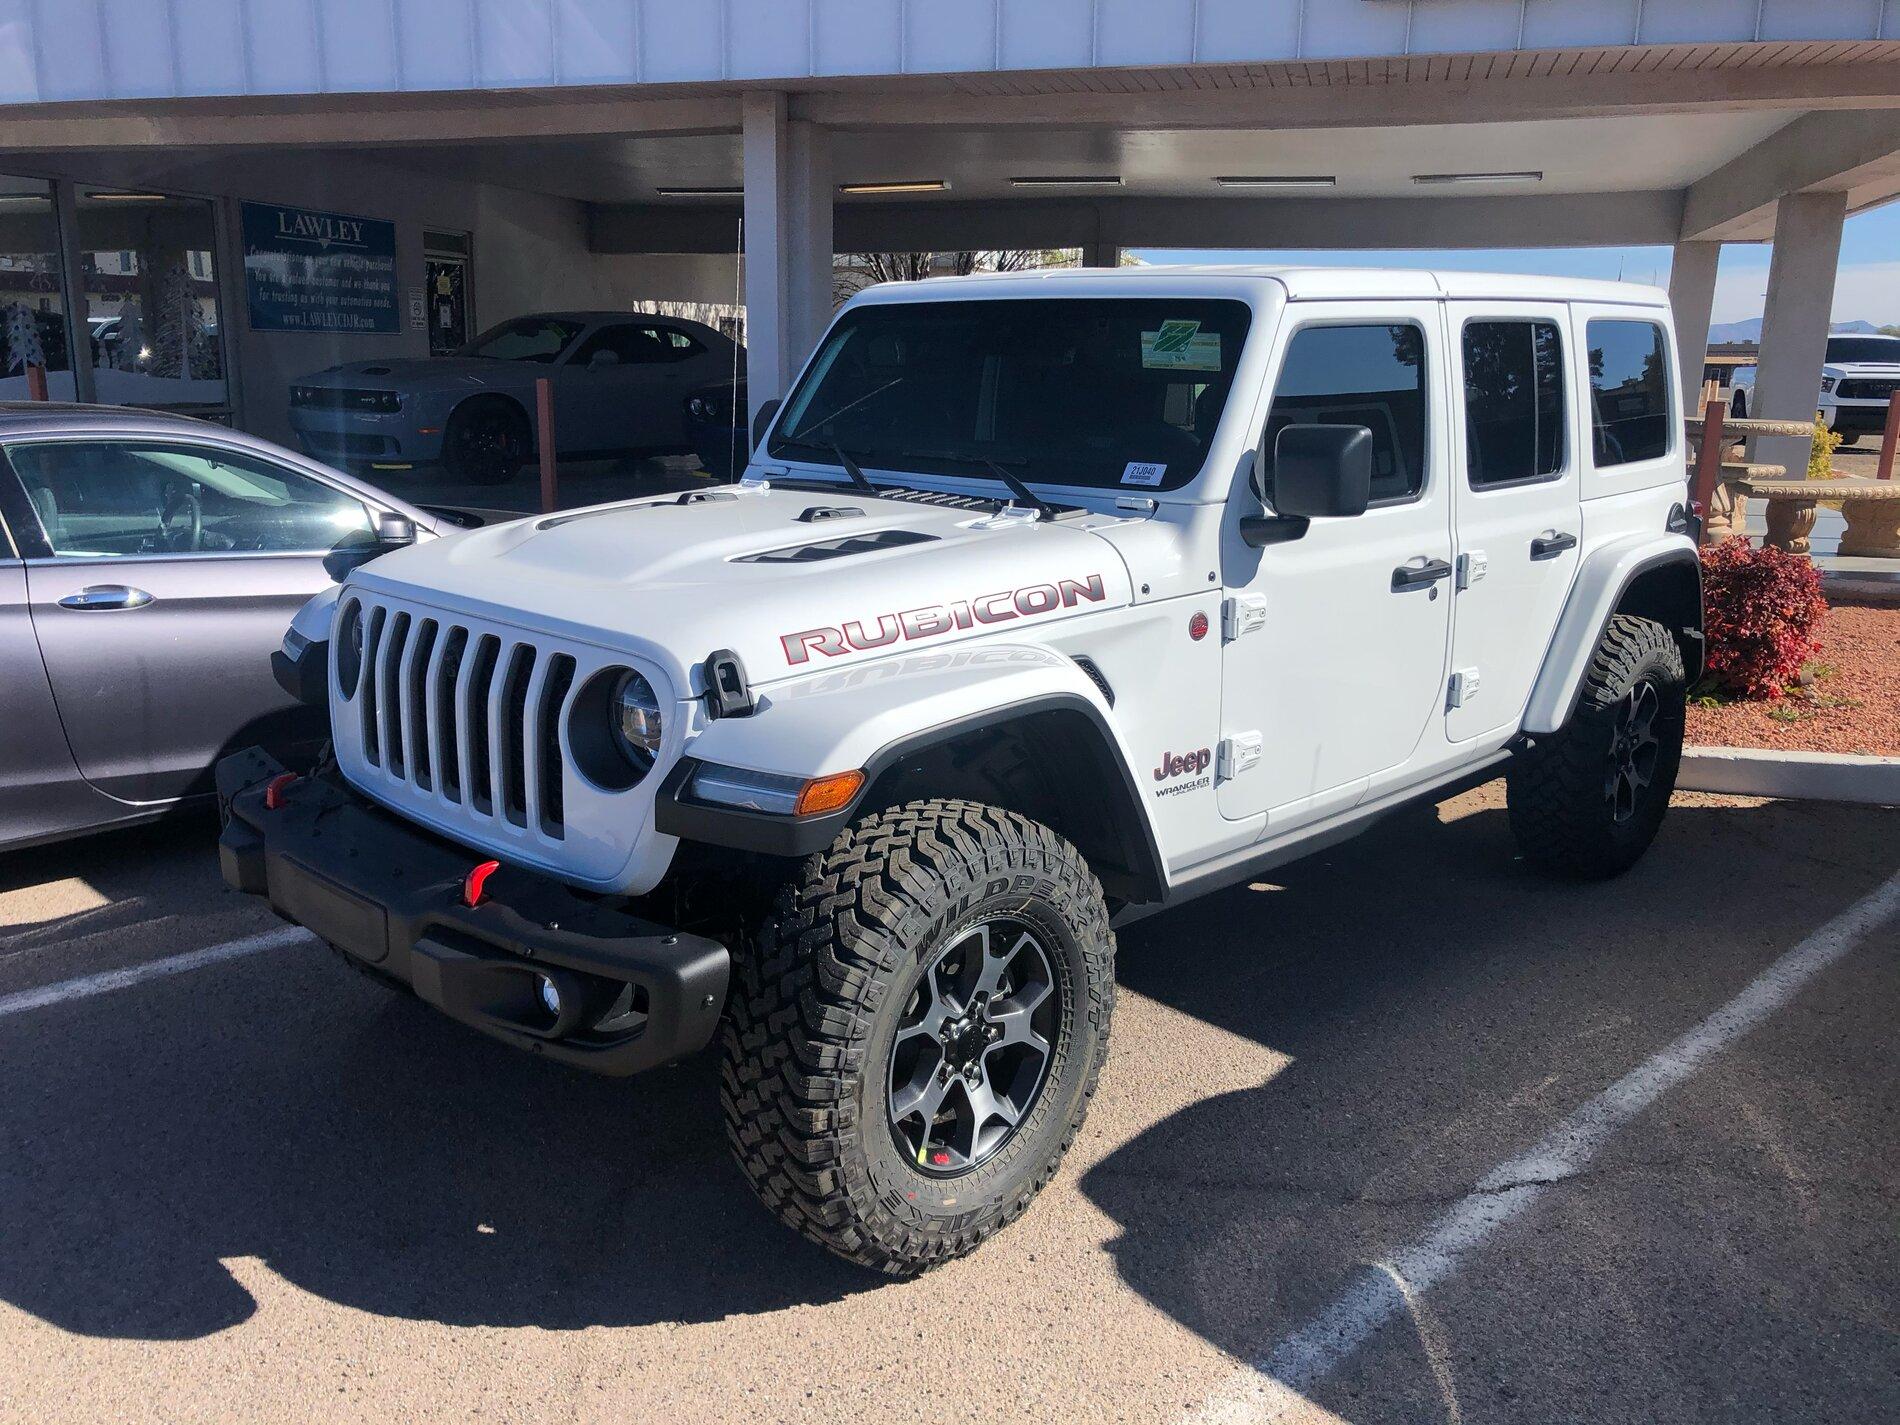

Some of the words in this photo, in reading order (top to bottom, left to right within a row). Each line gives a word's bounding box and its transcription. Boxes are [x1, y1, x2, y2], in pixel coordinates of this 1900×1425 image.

[278, 211, 364, 242] LAWLEY
[259, 287, 270, 302] for
[272, 290, 298, 307] trusting
[310, 292, 324, 304] with
[325, 295, 339, 307] your
[1130, 465, 1157, 476] 21J040
[779, 573, 1106, 666] RUBICON
[1153, 747, 1211, 782] Jeep
[1155, 776, 1210, 798] WRANGLER
